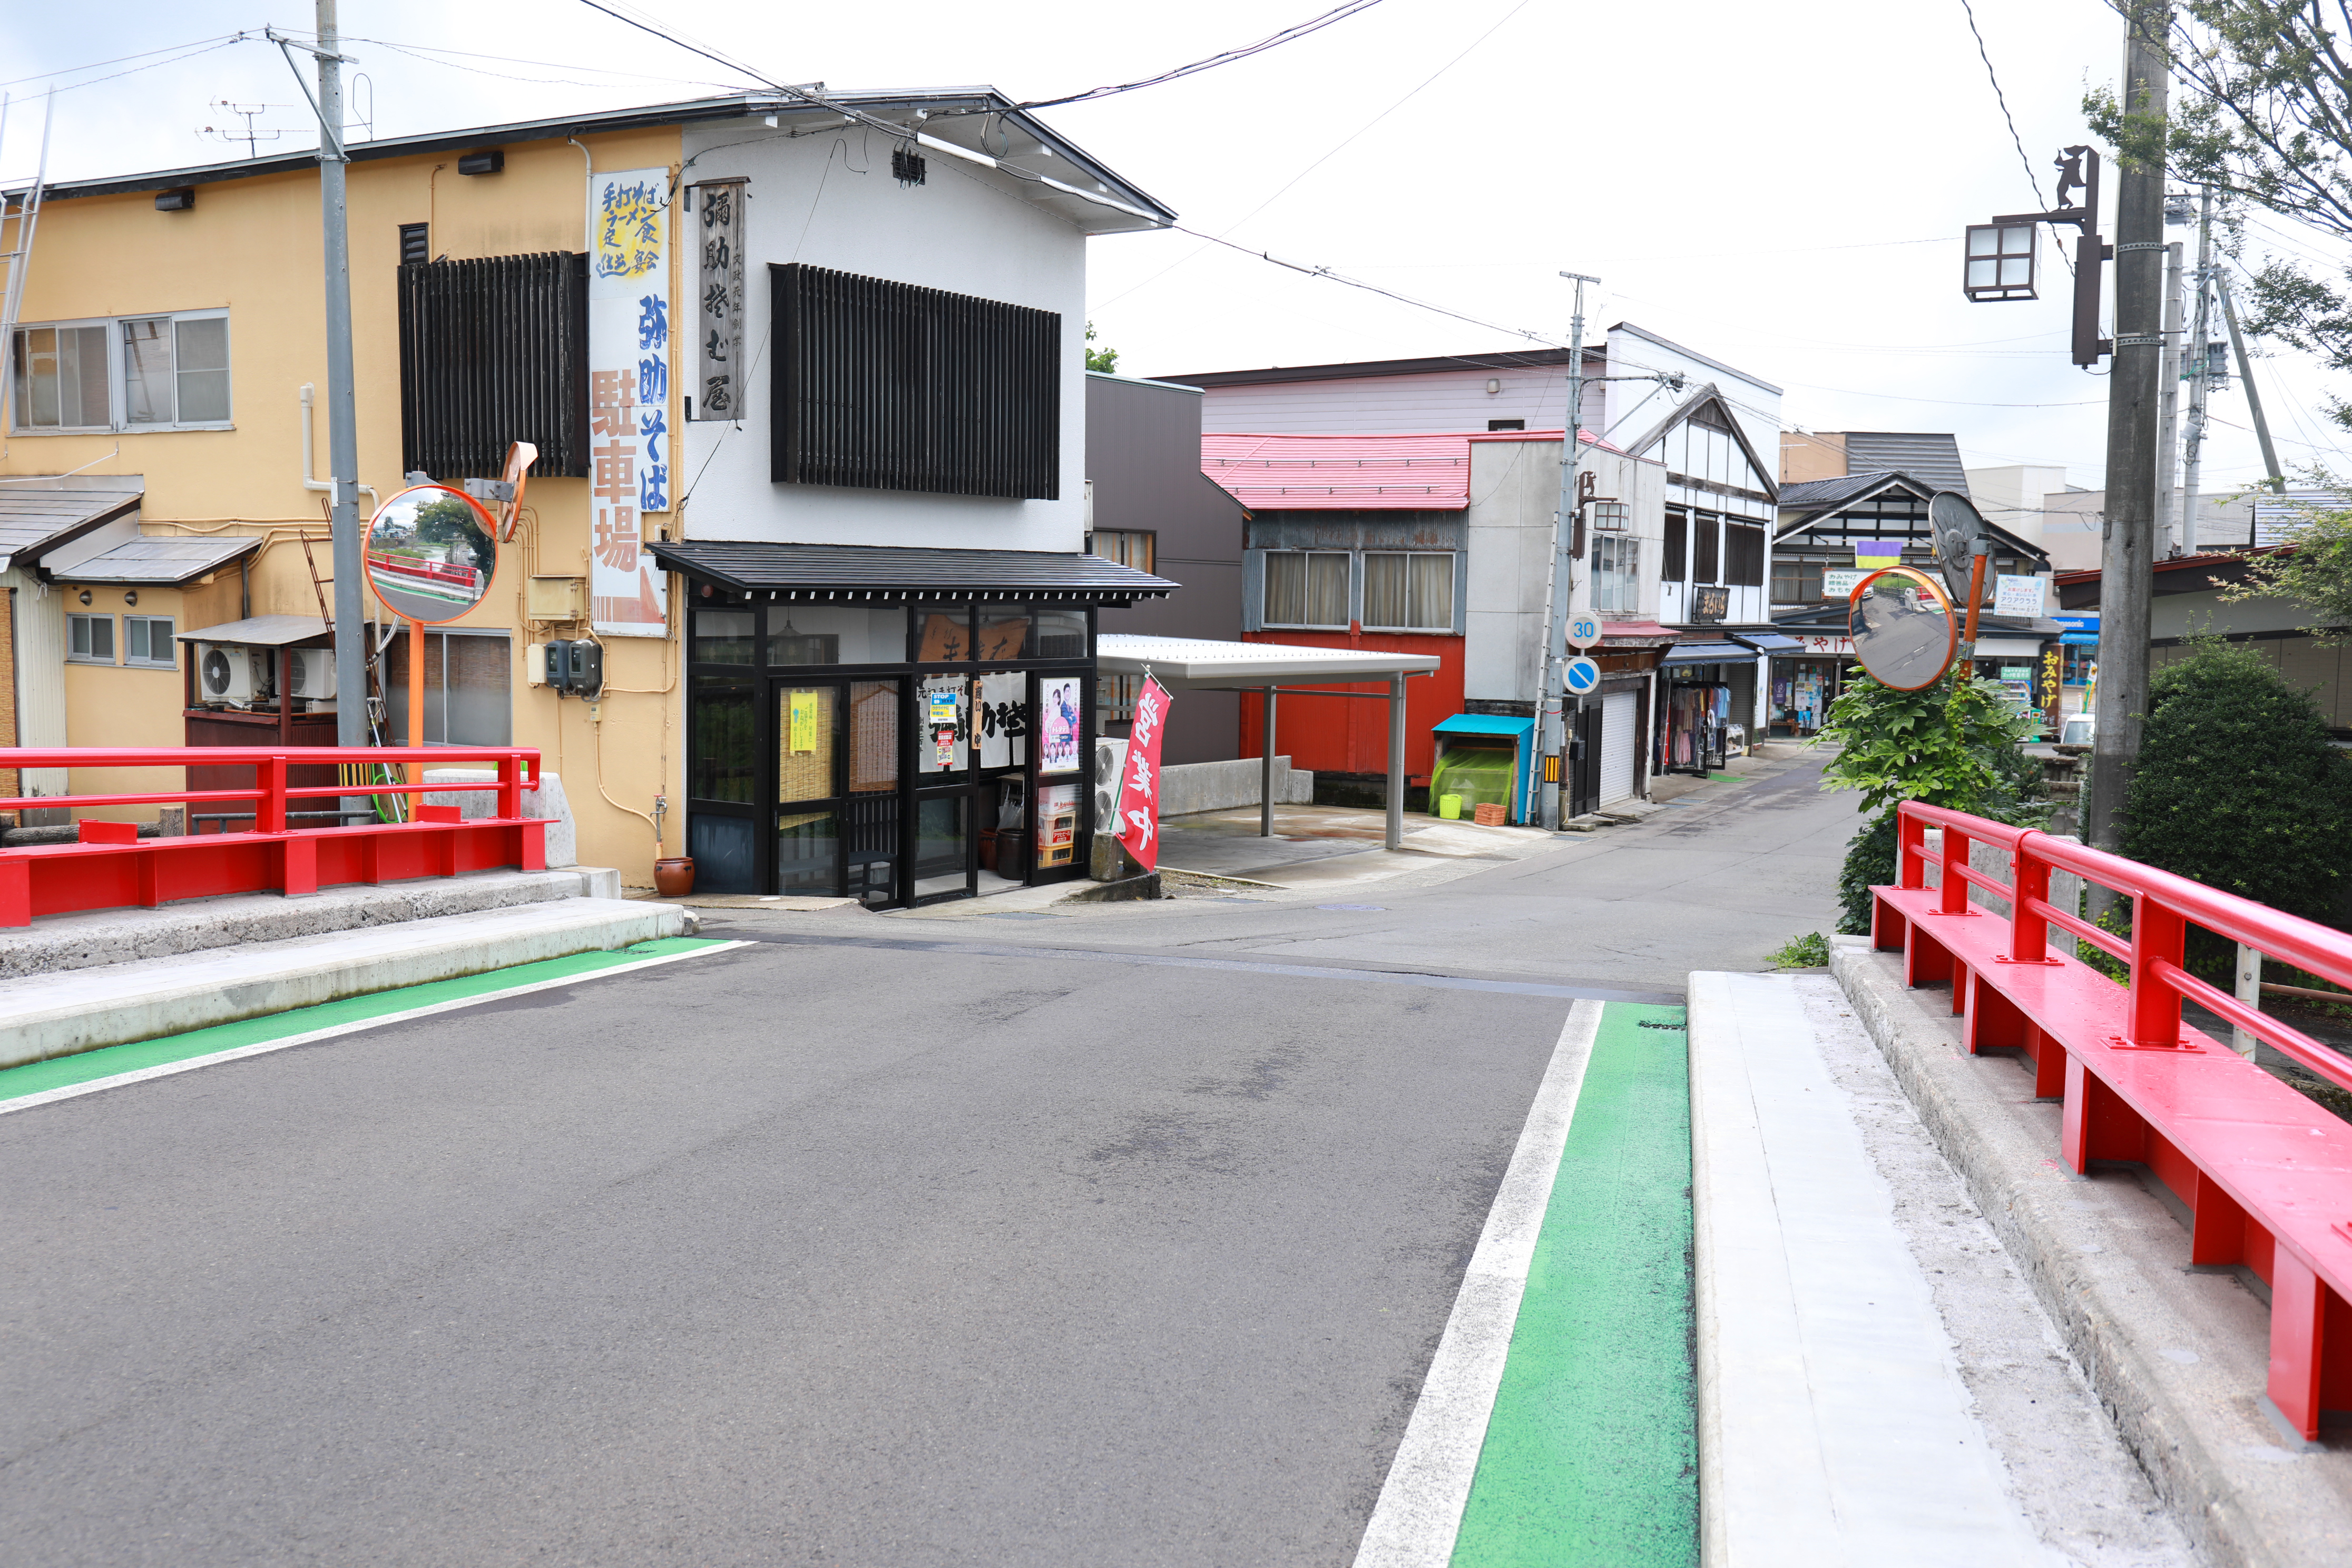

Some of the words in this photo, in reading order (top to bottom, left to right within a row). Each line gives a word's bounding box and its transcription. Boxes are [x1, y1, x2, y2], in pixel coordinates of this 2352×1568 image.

[602, 181, 659, 212] 手打そば
[606, 207, 656, 227] ラーメン
[632, 249, 659, 273] 宴会
[638, 293, 667, 511] 弥助そば
[592, 369, 638, 573] 駐車場
[1574, 622, 1593, 638] 30
[2041, 651, 2059, 708] おみやげ
[1127, 692, 1159, 851] 営業中
